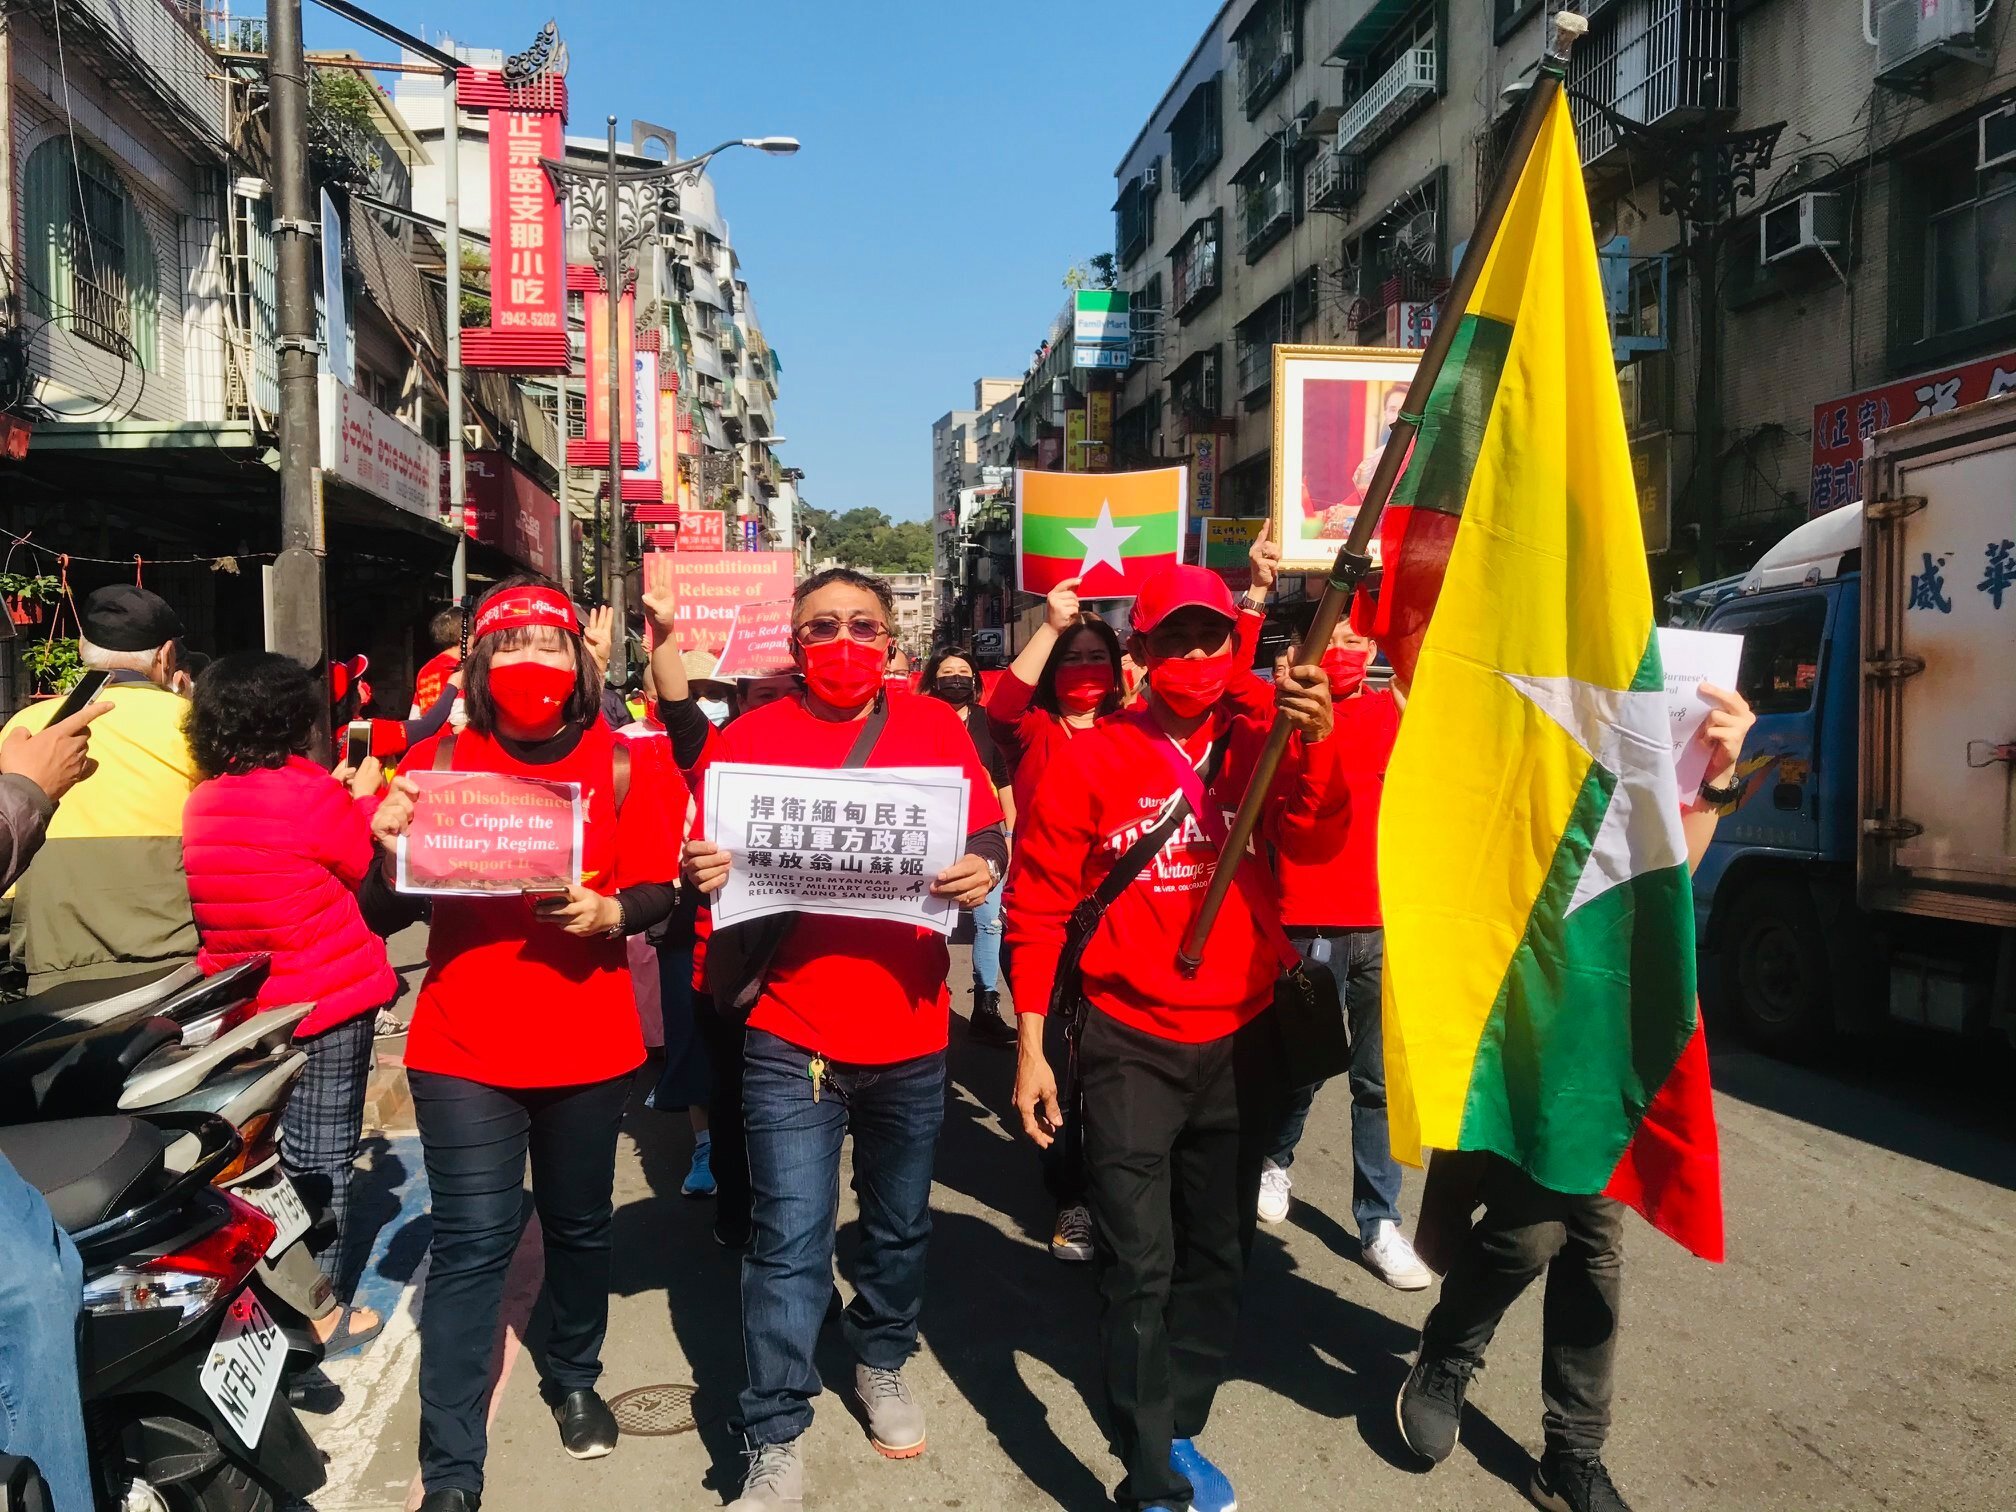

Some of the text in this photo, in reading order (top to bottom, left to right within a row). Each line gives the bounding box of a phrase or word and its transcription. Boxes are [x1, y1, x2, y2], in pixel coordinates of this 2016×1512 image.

[508, 112, 544, 305] 正宗密支那小吃
[500, 311, 558, 327] 2942-5202
[1078, 320, 1127, 329] FamilyMart
[675, 560, 777, 574] nconditional
[679, 582, 763, 597] Release of
[676, 632, 684, 642] n
[737, 629, 756, 640] The
[758, 624, 779, 637] Red
[747, 638, 790, 651] Campaig
[418, 789, 572, 809] Civil Disobedience
[750, 795, 927, 828] 捍衛緬甸民主
[433, 812, 553, 831] To Cripple the
[424, 834, 559, 854] Military Regime.
[748, 823, 927, 855] 反對軍方政變
[448, 858, 512, 873] Support
[747, 850, 924, 876] 釋放翁山蘇姬
[748, 880, 801, 889] AGAINST
[806, 883, 861, 891] MILITARY
[749, 872, 793, 881] JUSTICE
[827, 877, 890, 886] MYANMAR
[749, 888, 797, 897] RELEASE
[871, 893, 895, 901] SUU
[900, 894, 919, 903] KYI
[216, 1302, 277, 1429] NFB-1762
